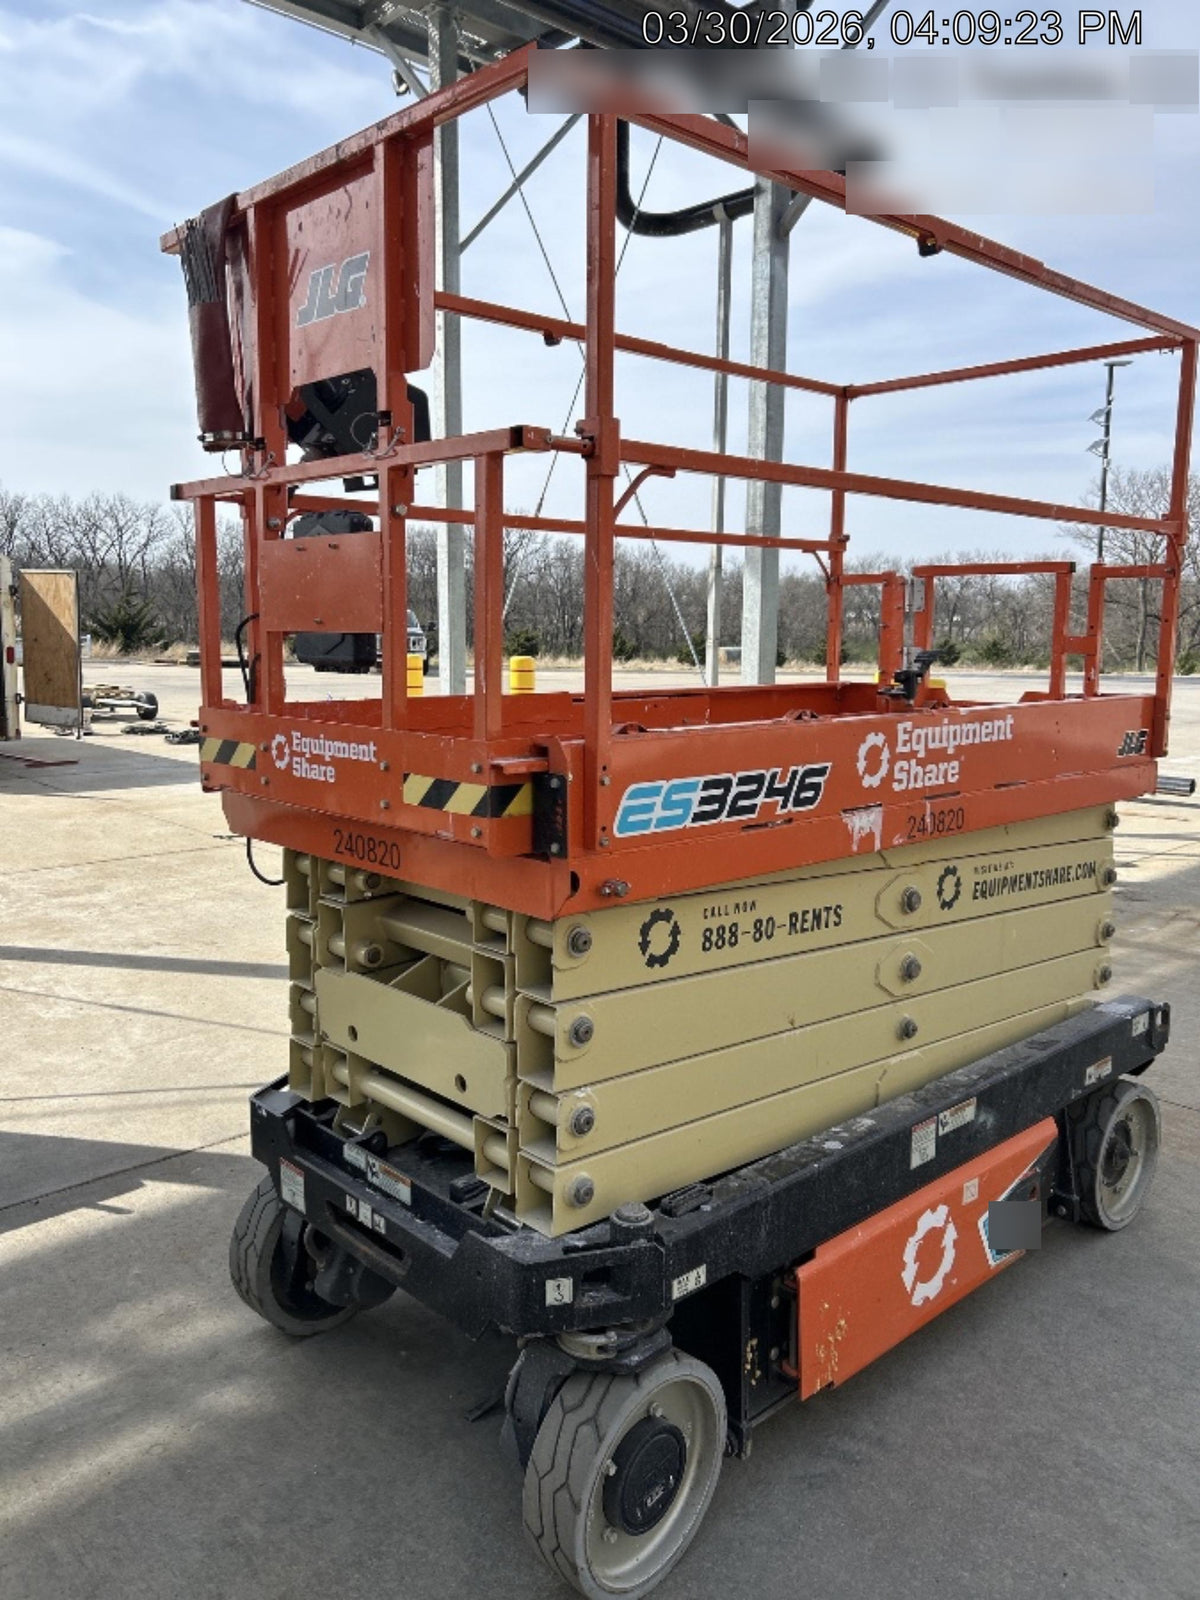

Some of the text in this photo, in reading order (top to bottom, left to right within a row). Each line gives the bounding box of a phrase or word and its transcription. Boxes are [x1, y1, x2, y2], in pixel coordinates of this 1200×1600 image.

[296, 251, 370, 328] JLG
[291, 730, 377, 763] Equipment
[896, 714, 1014, 757] Equipment
[293, 758, 335, 784] Share
[892, 759, 960, 792] Share
[613, 761, 832, 839] ES3246
[907, 805, 965, 840] 240820
[333, 829, 401, 870] 240820
[972, 861, 1097, 900] EQUIPMENTSHARE.COM
[701, 904, 843, 952] 888-80-RENTS
[703, 907, 730, 919] CALL
